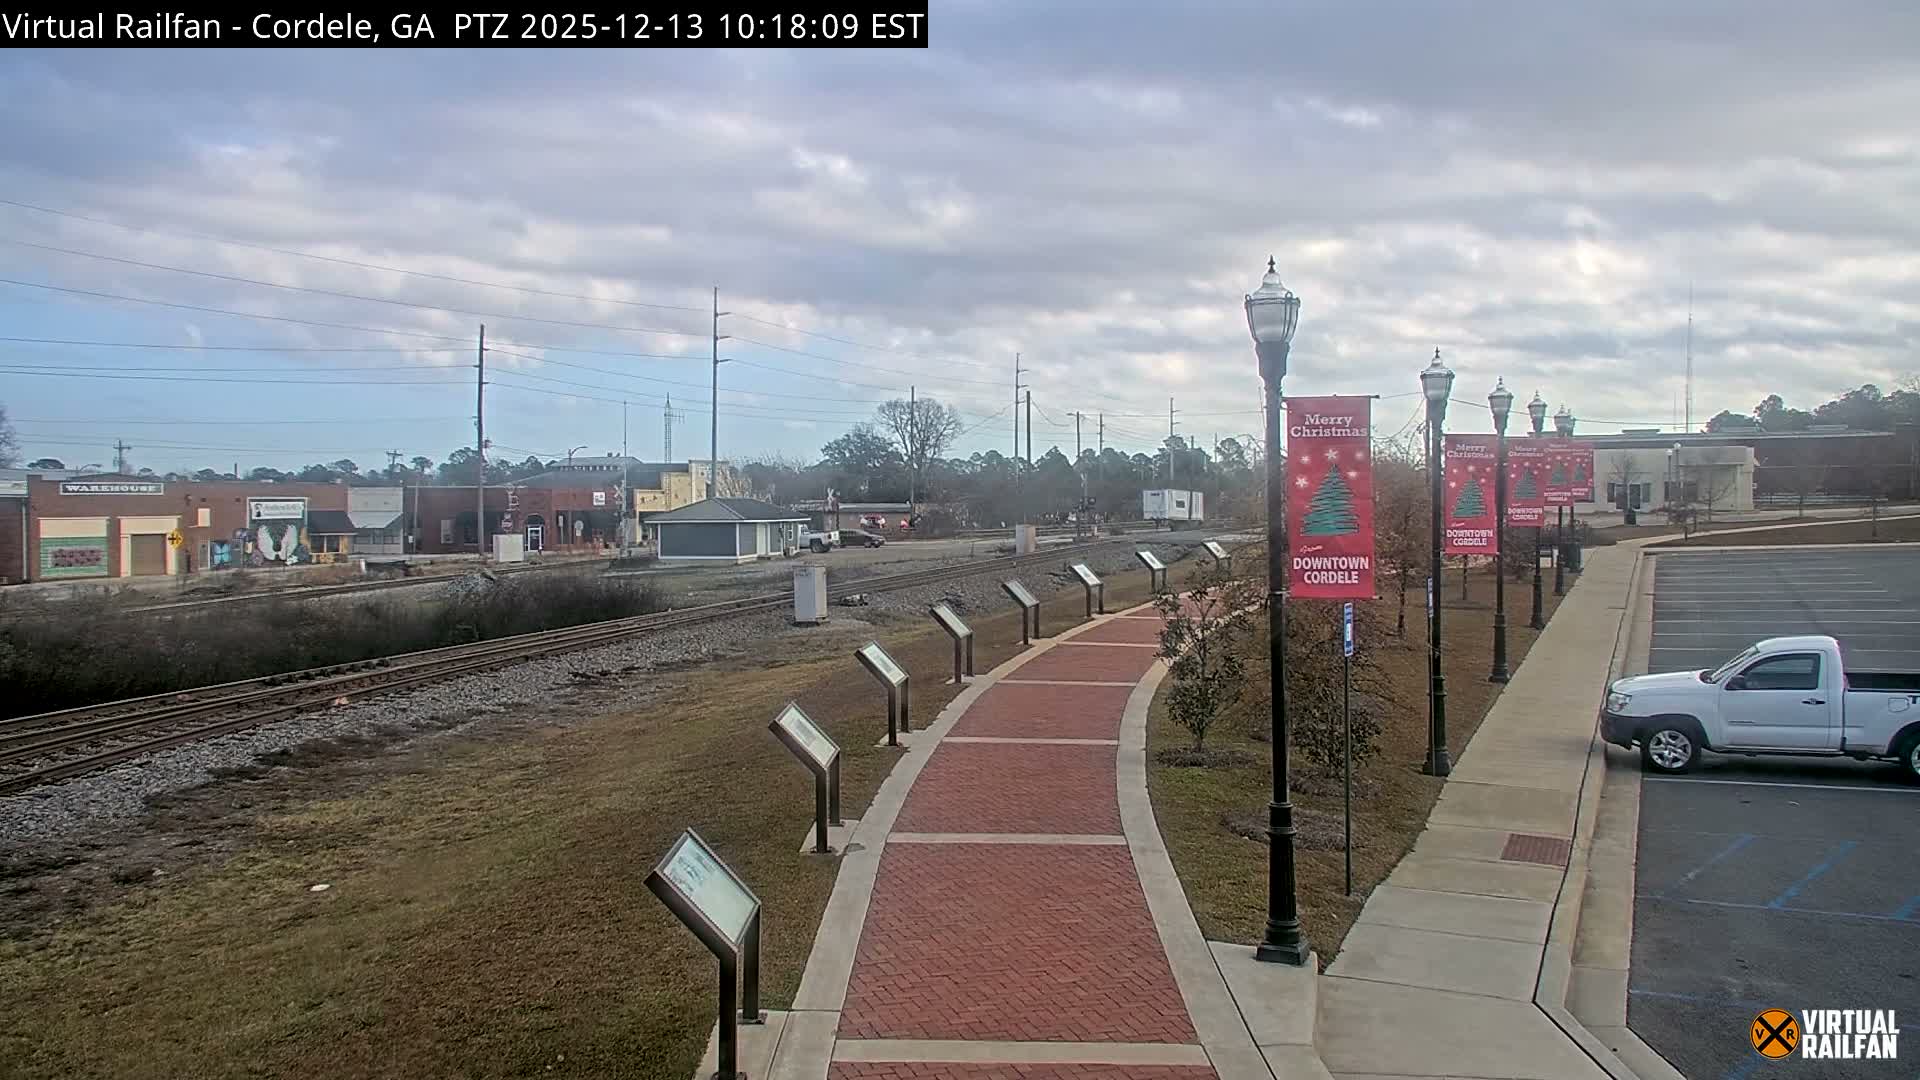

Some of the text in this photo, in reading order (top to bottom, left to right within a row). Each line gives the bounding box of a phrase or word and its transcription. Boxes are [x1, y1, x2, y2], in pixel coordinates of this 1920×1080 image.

[1305, 414, 1352, 427] Merry
[1291, 426, 1368, 437] Christmas
[1446, 529, 1493, 538] DOWNTOWN
[1293, 556, 1369, 570] DOWNTOWN
[1304, 570, 1359, 584] CORDELE
